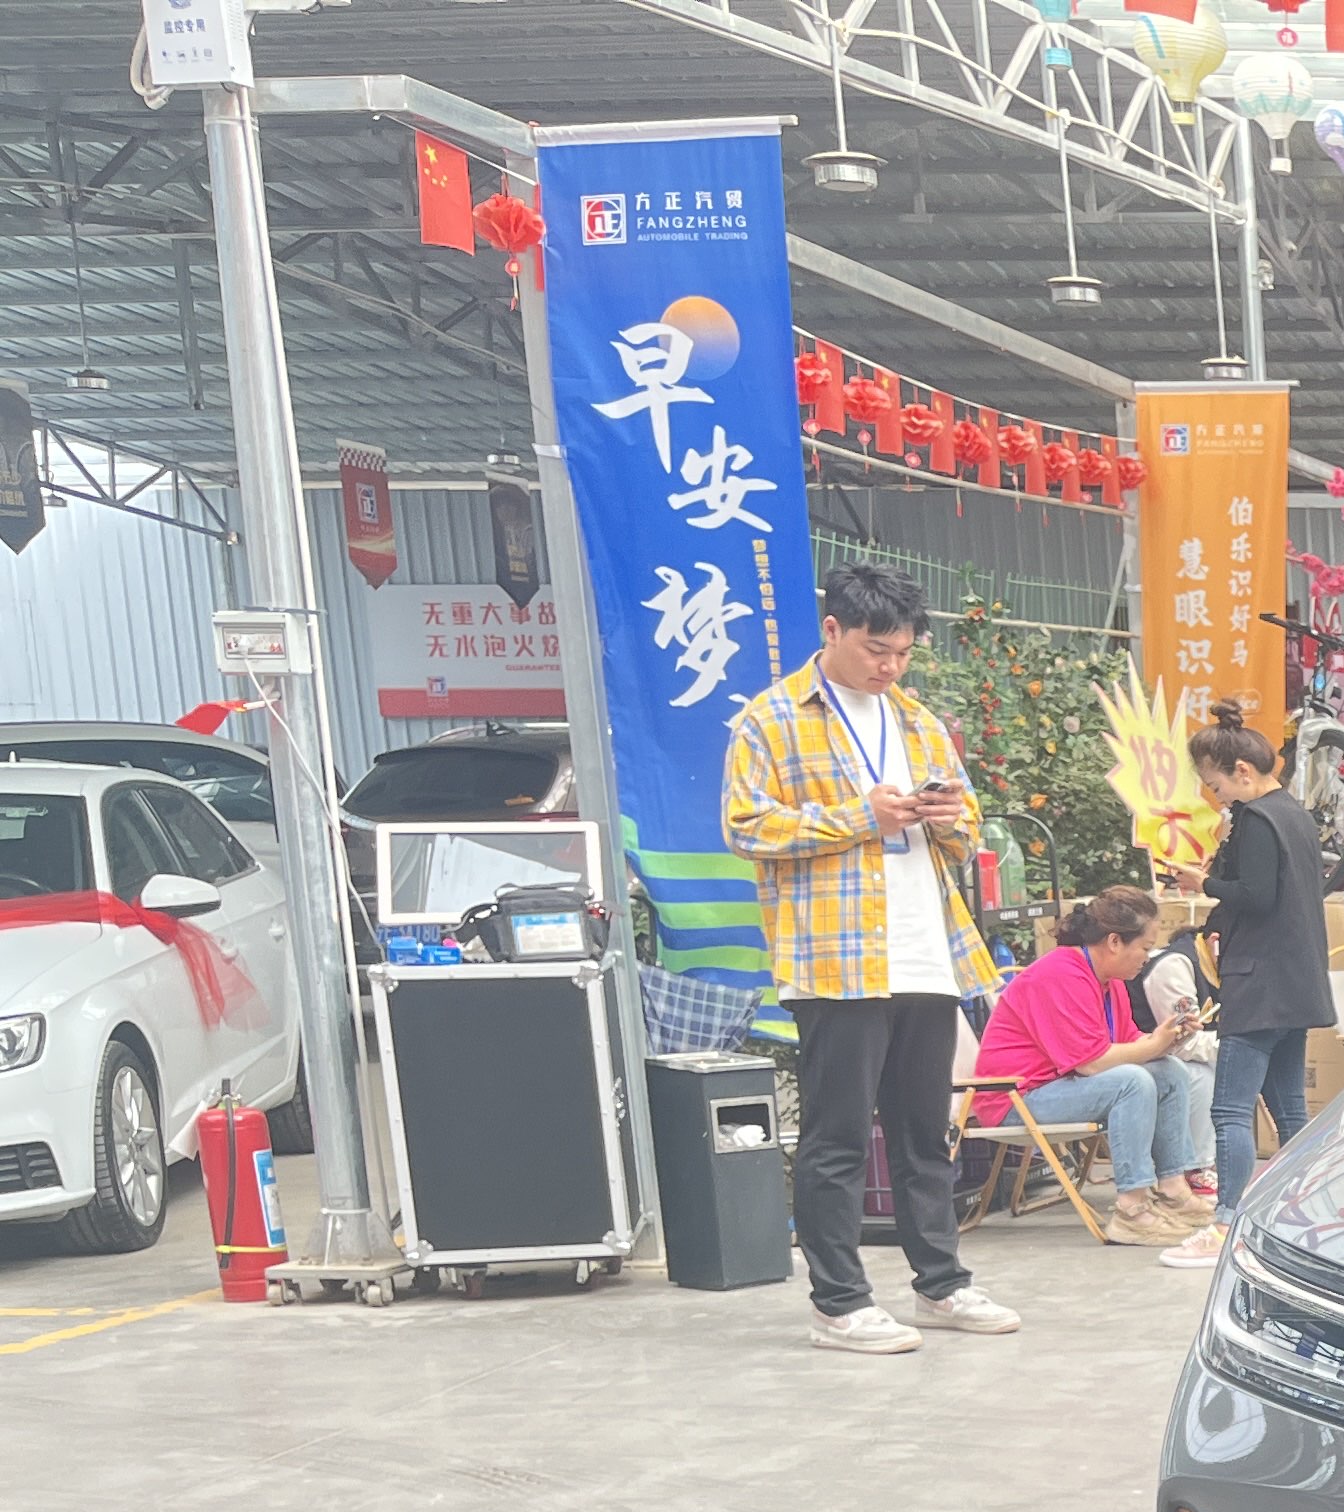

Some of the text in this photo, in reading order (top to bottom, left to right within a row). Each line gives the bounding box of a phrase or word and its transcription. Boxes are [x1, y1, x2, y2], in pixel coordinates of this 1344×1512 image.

[635, 190, 743, 211] 方正汽贸
[637, 215, 747, 229] FANGZHENG
[637, 231, 748, 242] AUTOMOBILE TRADING
[591, 322, 778, 728] 早安梦
[1227, 496, 1253, 668] 伯乐识好马
[422, 601, 557, 626] 无重大事故
[1174, 537, 1214, 738] 慧眼识好
